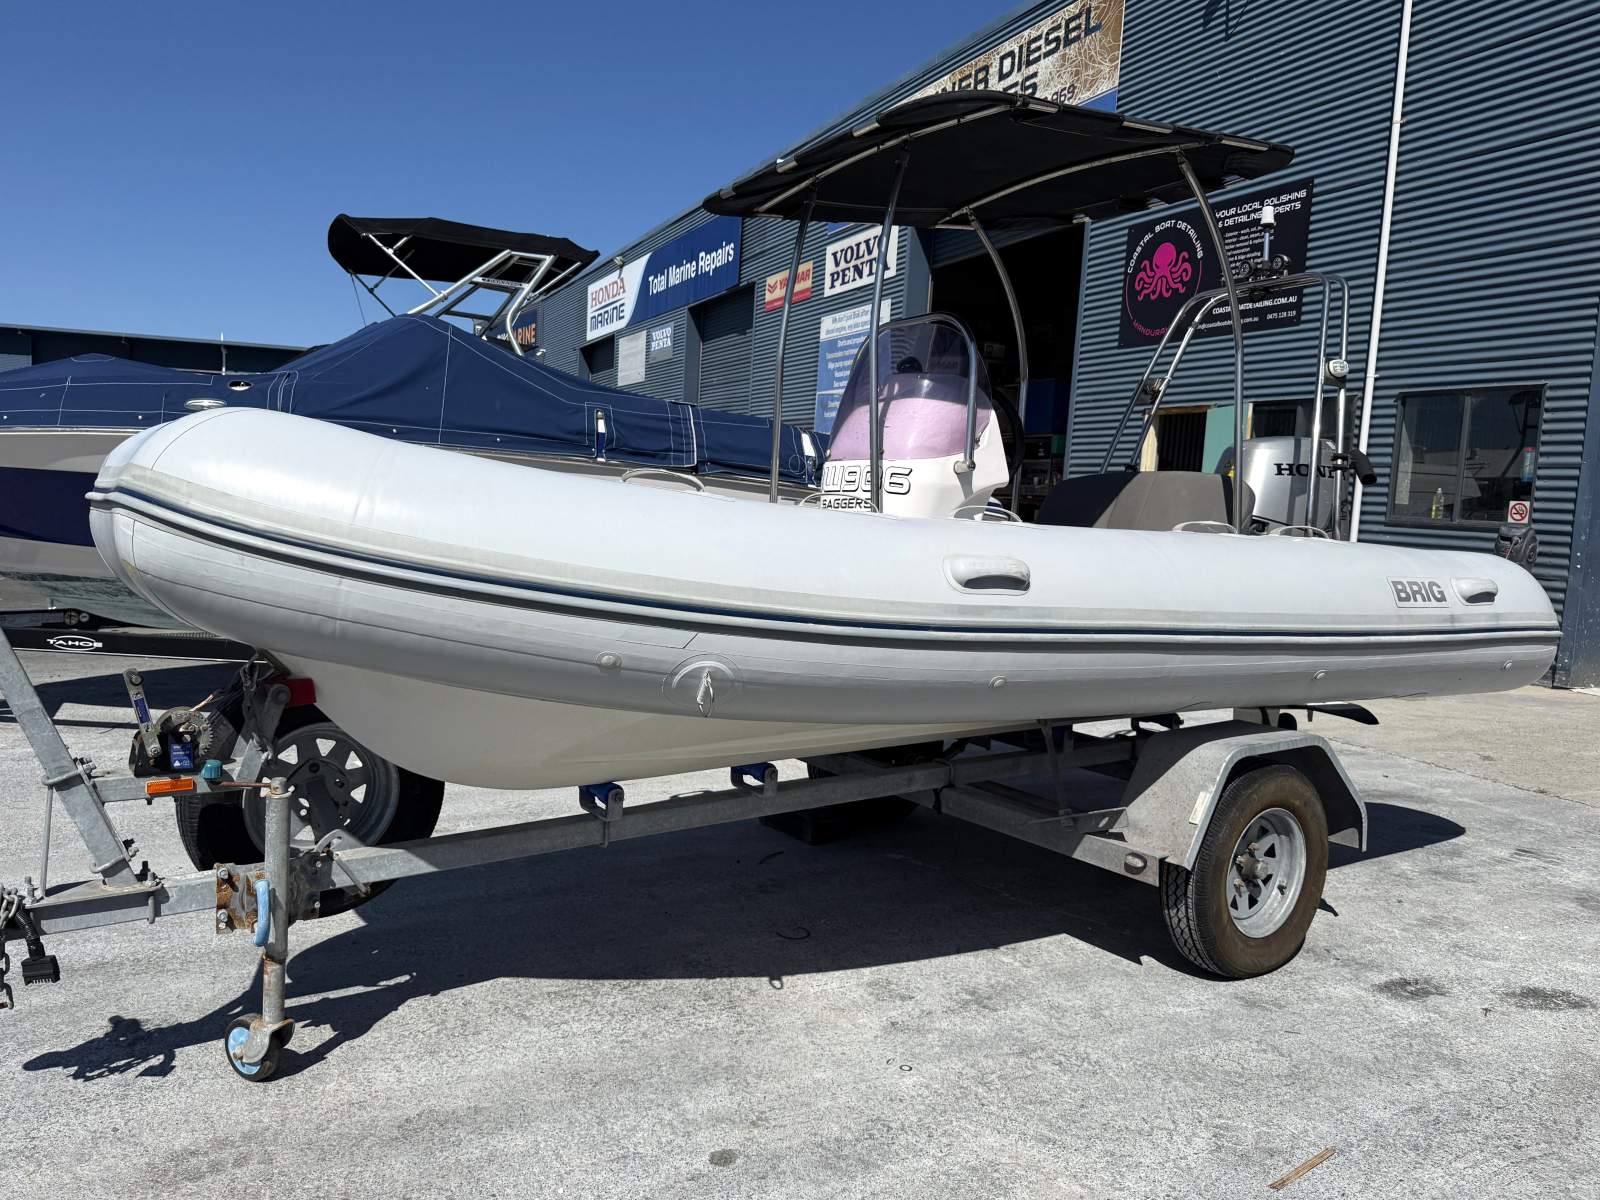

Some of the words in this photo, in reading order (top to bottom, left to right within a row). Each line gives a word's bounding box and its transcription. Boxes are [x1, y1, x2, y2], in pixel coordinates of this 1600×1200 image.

[998, 4, 1102, 84] DIESEL
[1215, 207, 1237, 219] YOUR
[1237, 201, 1263, 214] LOCAL
[1263, 189, 1307, 207] POLISHING
[1224, 210, 1264, 227] DETAILING
[831, 235, 879, 269] VOLV
[1127, 232, 1154, 273] COASTAL
[1154, 220, 1176, 233] BOAT
[1176, 220, 1204, 259] DETAILING
[648, 268, 668, 297] Total
[668, 259, 697, 288] Marine
[698, 241, 735, 276] Repairs
[591, 276, 626, 309] HONDA
[512, 323, 537, 345] RINE
[651, 338, 672, 351] PENTA
[652, 327, 672, 341] VOLVO
[1390, 580, 1448, 603] BRIG
[46, 638, 103, 648] TAHOE
